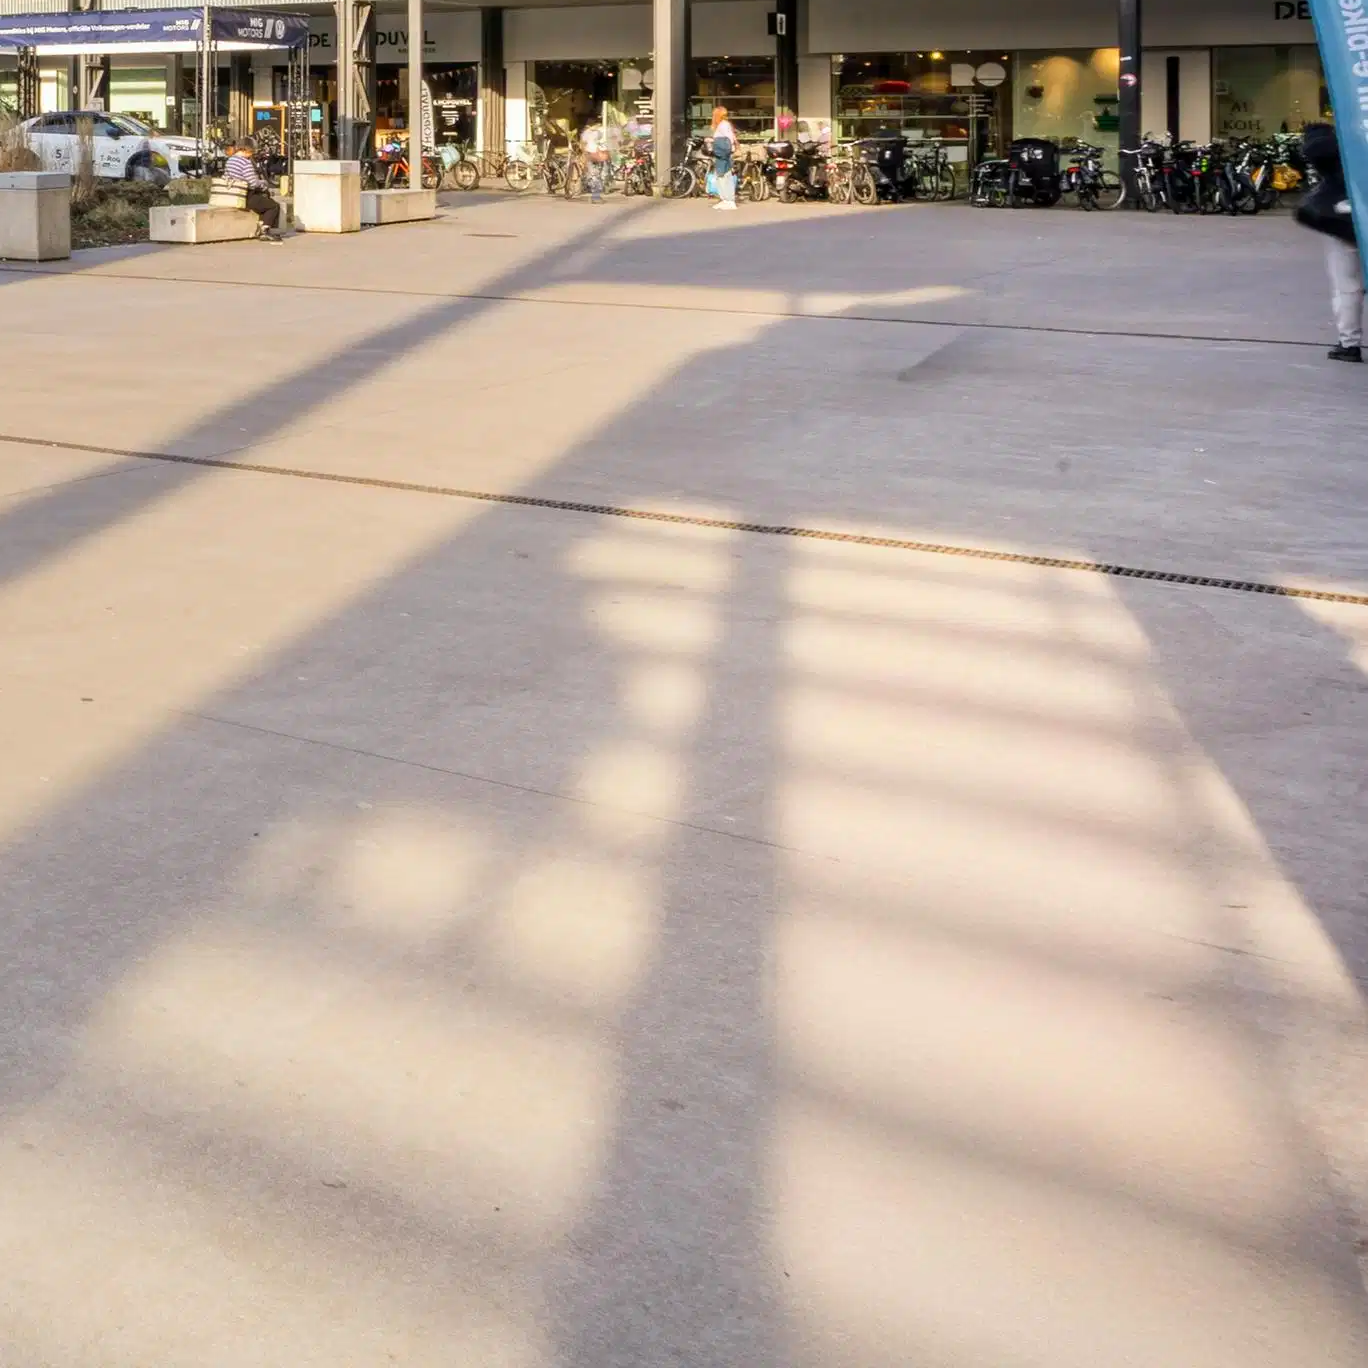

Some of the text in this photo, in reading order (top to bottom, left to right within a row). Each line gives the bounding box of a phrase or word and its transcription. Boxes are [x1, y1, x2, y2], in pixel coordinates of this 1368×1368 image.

[1274, 1, 1312, 20] DE
[237, 28, 263, 39] MOTORS
[310, 34, 331, 47] DE
